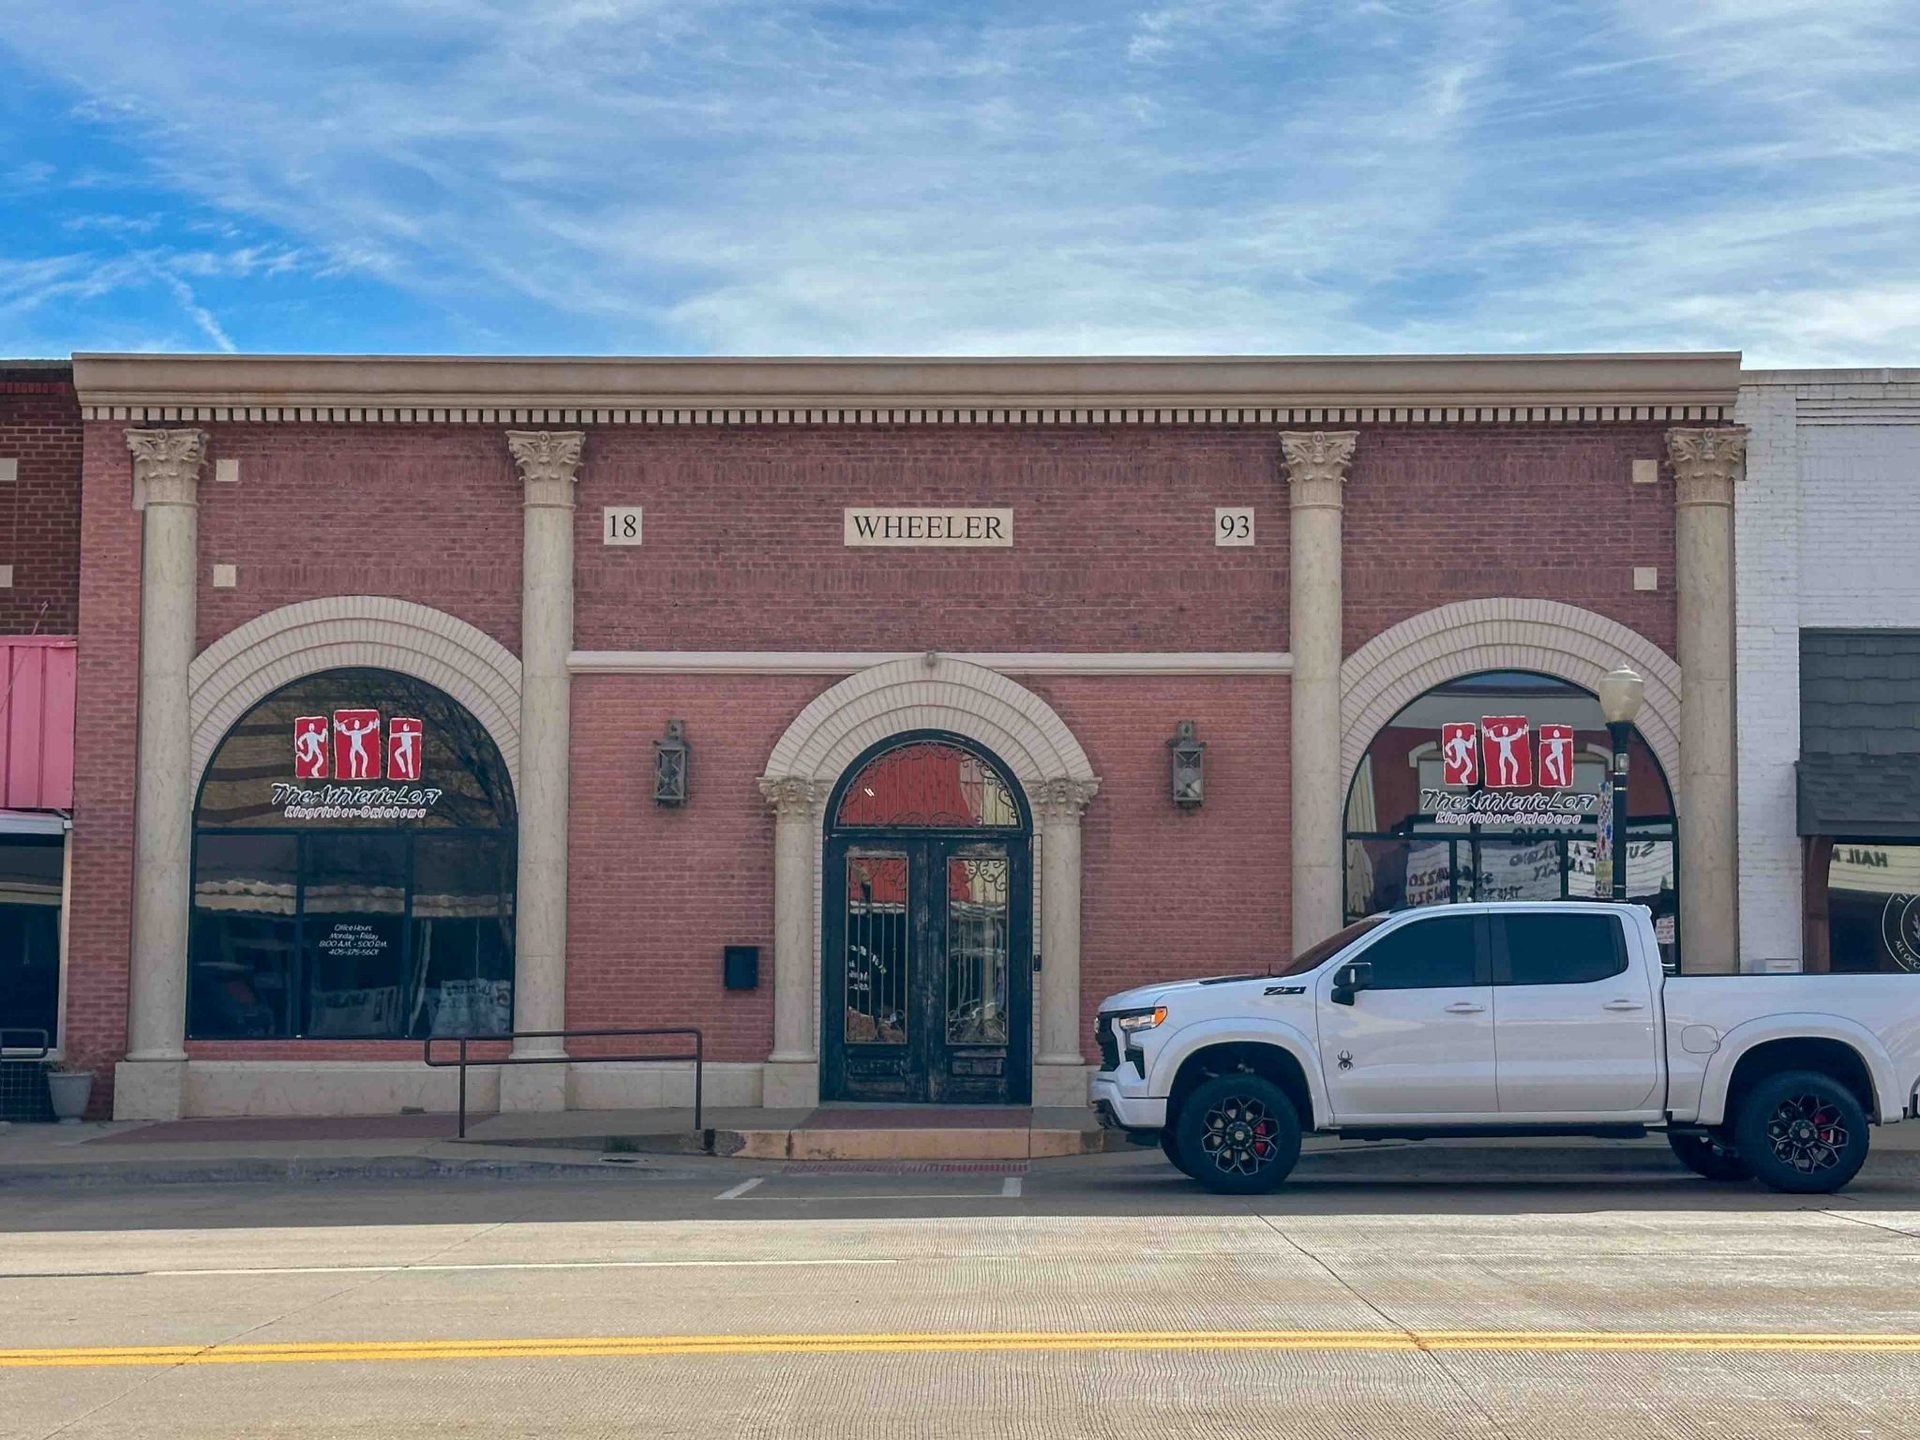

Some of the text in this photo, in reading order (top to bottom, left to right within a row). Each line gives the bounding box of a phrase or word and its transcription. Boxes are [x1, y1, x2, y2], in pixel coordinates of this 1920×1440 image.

[610, 514, 637, 538] 18
[853, 515, 1005, 539] WHEELER
[1220, 515, 1250, 539] 93
